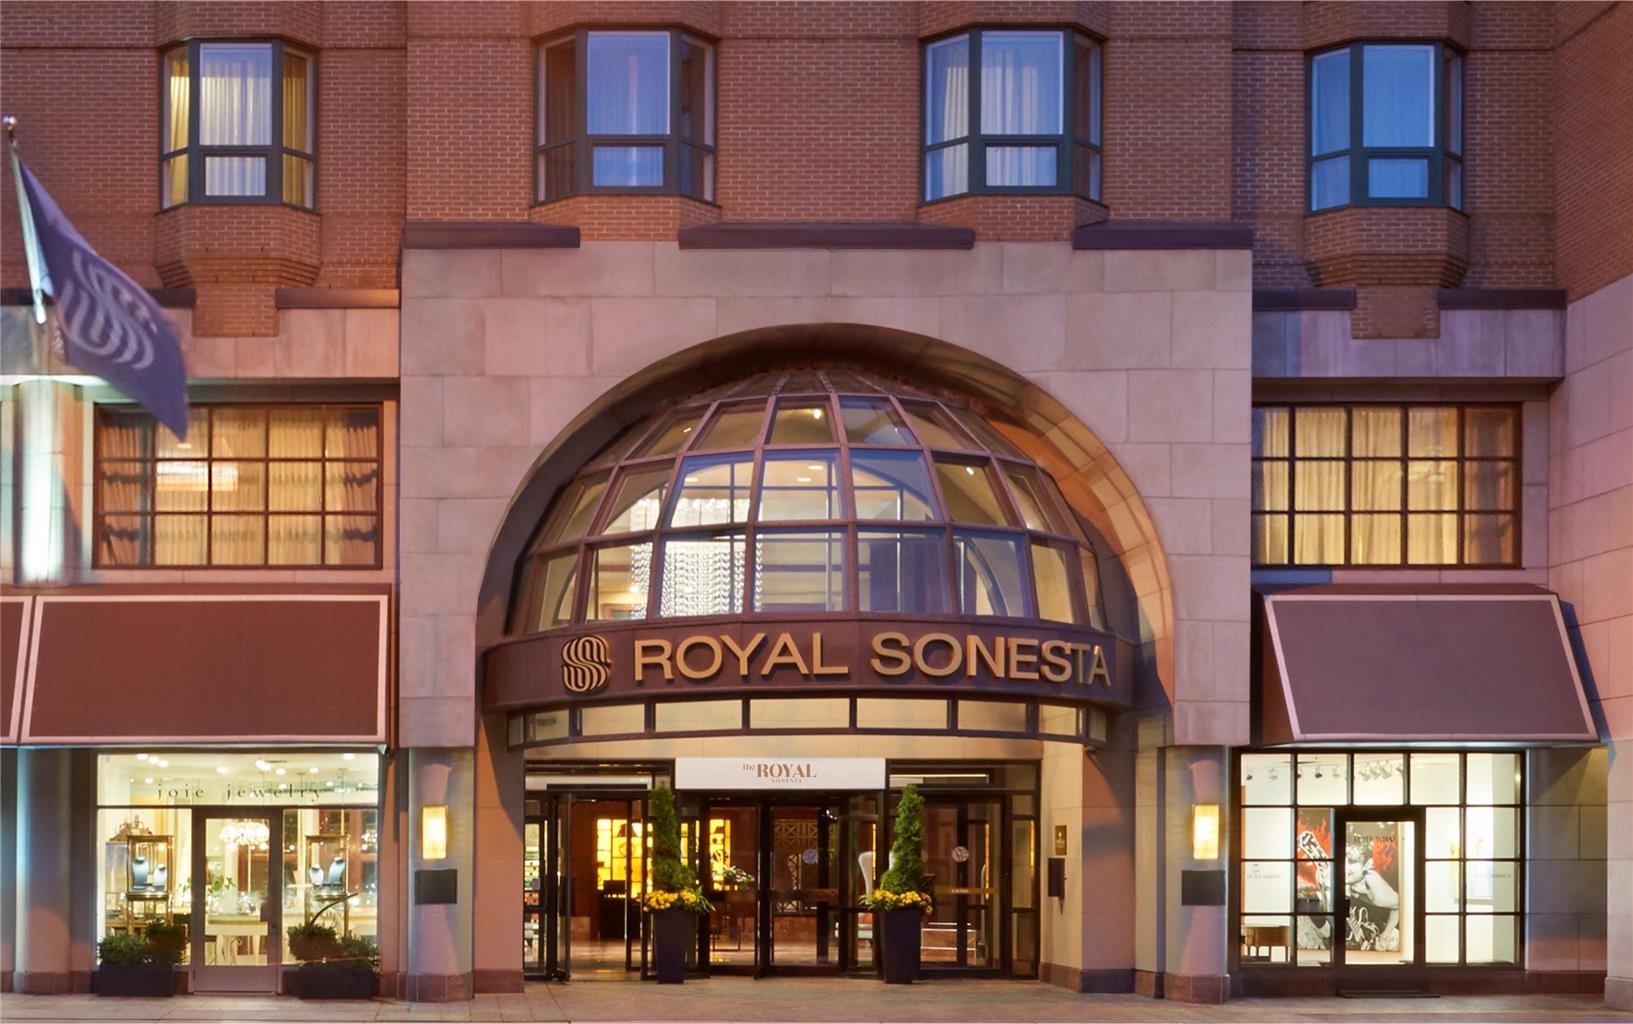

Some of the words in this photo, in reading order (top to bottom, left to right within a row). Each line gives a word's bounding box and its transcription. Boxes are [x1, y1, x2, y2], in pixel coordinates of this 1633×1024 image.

[634, 632, 849, 682] ROYAL
[870, 631, 1111, 687] SONESTA
[757, 763, 817, 778] ROYAL
[157, 783, 204, 800] joie
[226, 783, 322, 802] jewelry
